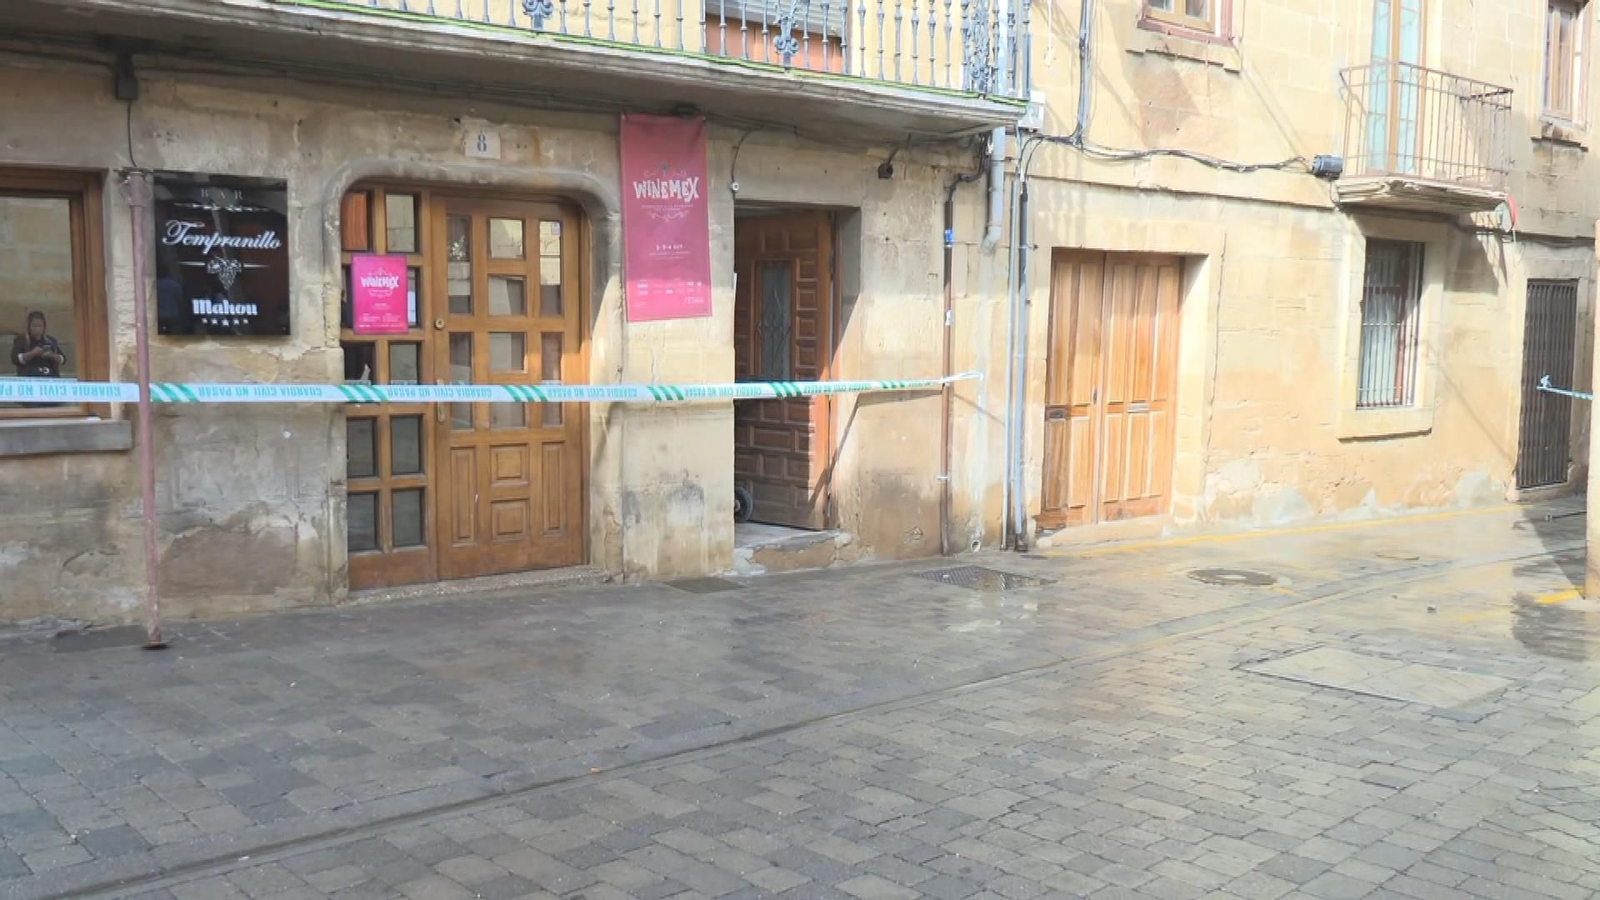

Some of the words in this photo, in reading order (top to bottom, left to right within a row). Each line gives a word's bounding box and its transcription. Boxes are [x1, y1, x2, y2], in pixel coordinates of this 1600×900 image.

[476, 133, 487, 152] 8
[633, 176, 700, 203] WINEMEX
[162, 219, 282, 255] Tempranillo
[192, 298, 258, 316] Mahou
[18, 384, 34, 396] NO
[40, 384, 67, 397] CIVIL
[72, 385, 121, 396] GUARDIA
[199, 386, 232, 396] PASAR
[236, 386, 249, 396] NO
[254, 386, 276, 396] CIVIL
[281, 386, 322, 396] GUARDIA
